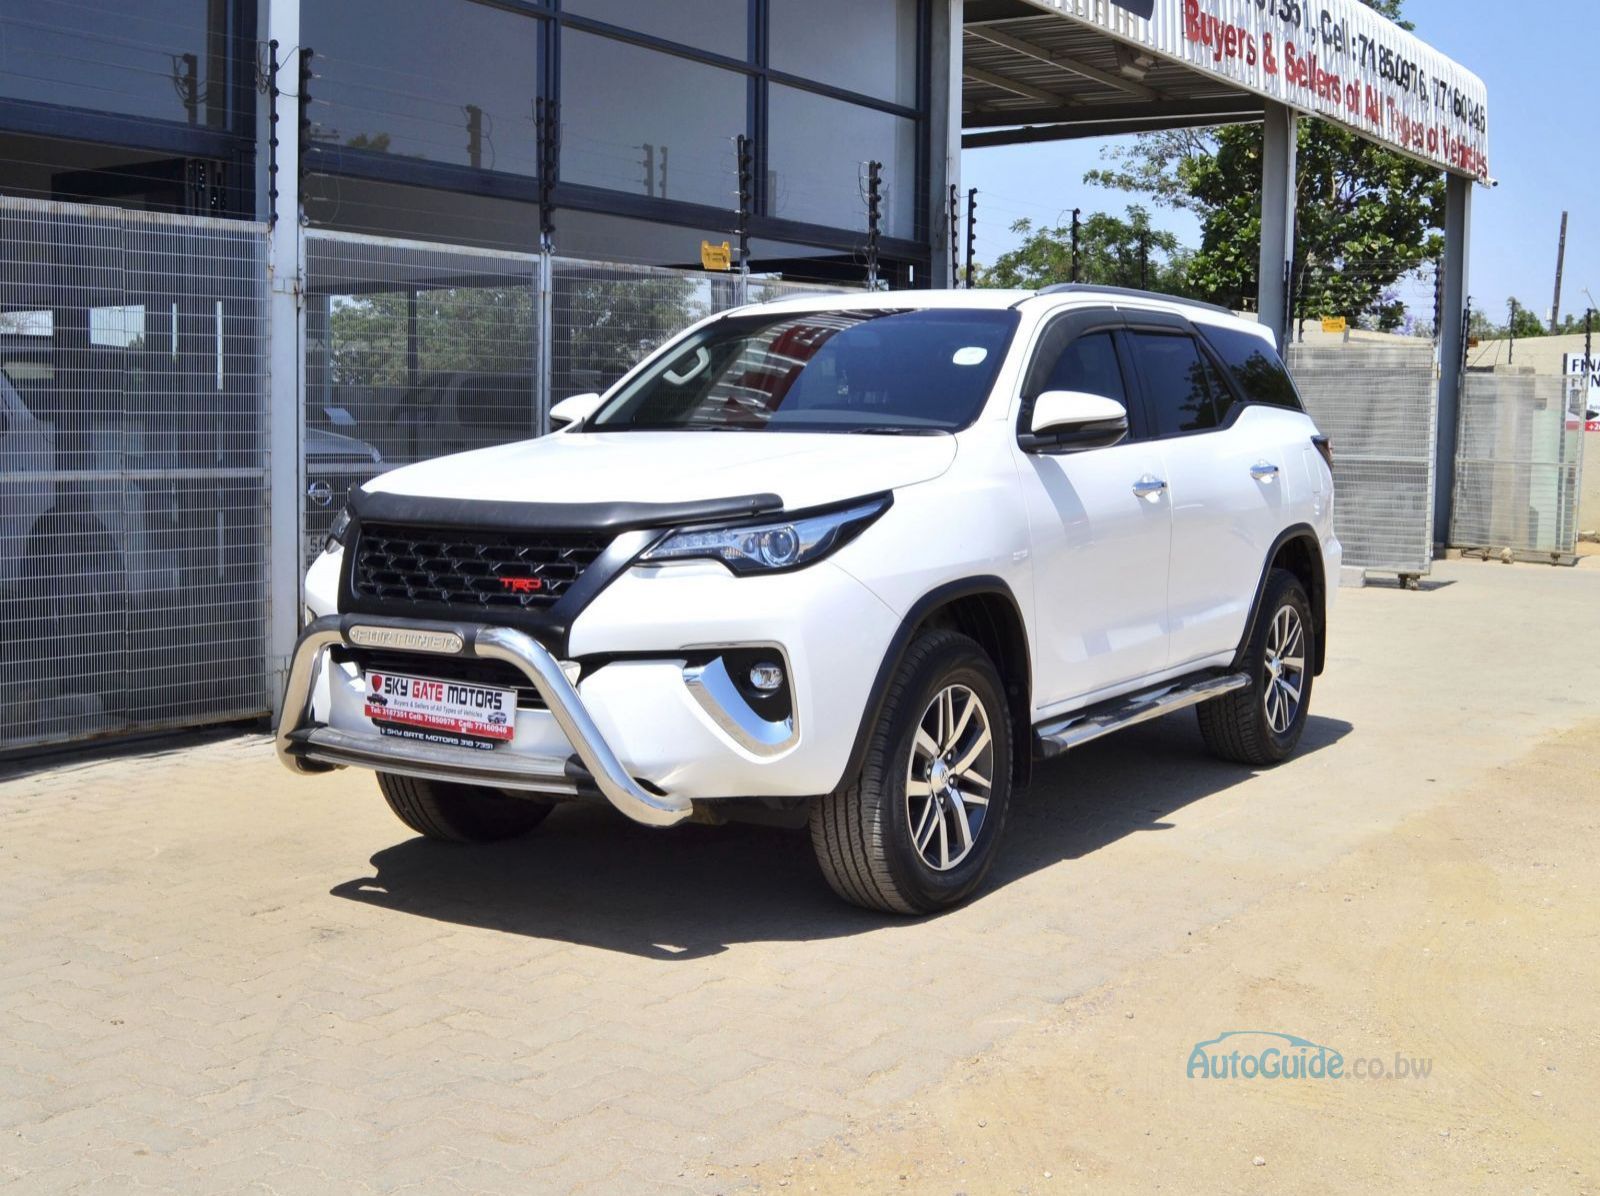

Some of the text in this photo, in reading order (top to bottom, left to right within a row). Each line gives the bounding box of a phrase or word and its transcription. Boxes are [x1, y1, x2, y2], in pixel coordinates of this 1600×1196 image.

[1184, 0, 1257, 66] Buyers
[1263, 32, 1277, 75] &
[1284, 41, 1341, 105] Sellers
[1346, 79, 1360, 115] of
[1364, 83, 1384, 128] All
[498, 577, 542, 593] TRD
[384, 677, 503, 710] SKY GATE MOTORS
[386, 728, 403, 736] SKY
[403, 731, 425, 740] GATE
[425, 734, 459, 745] MOTORS
